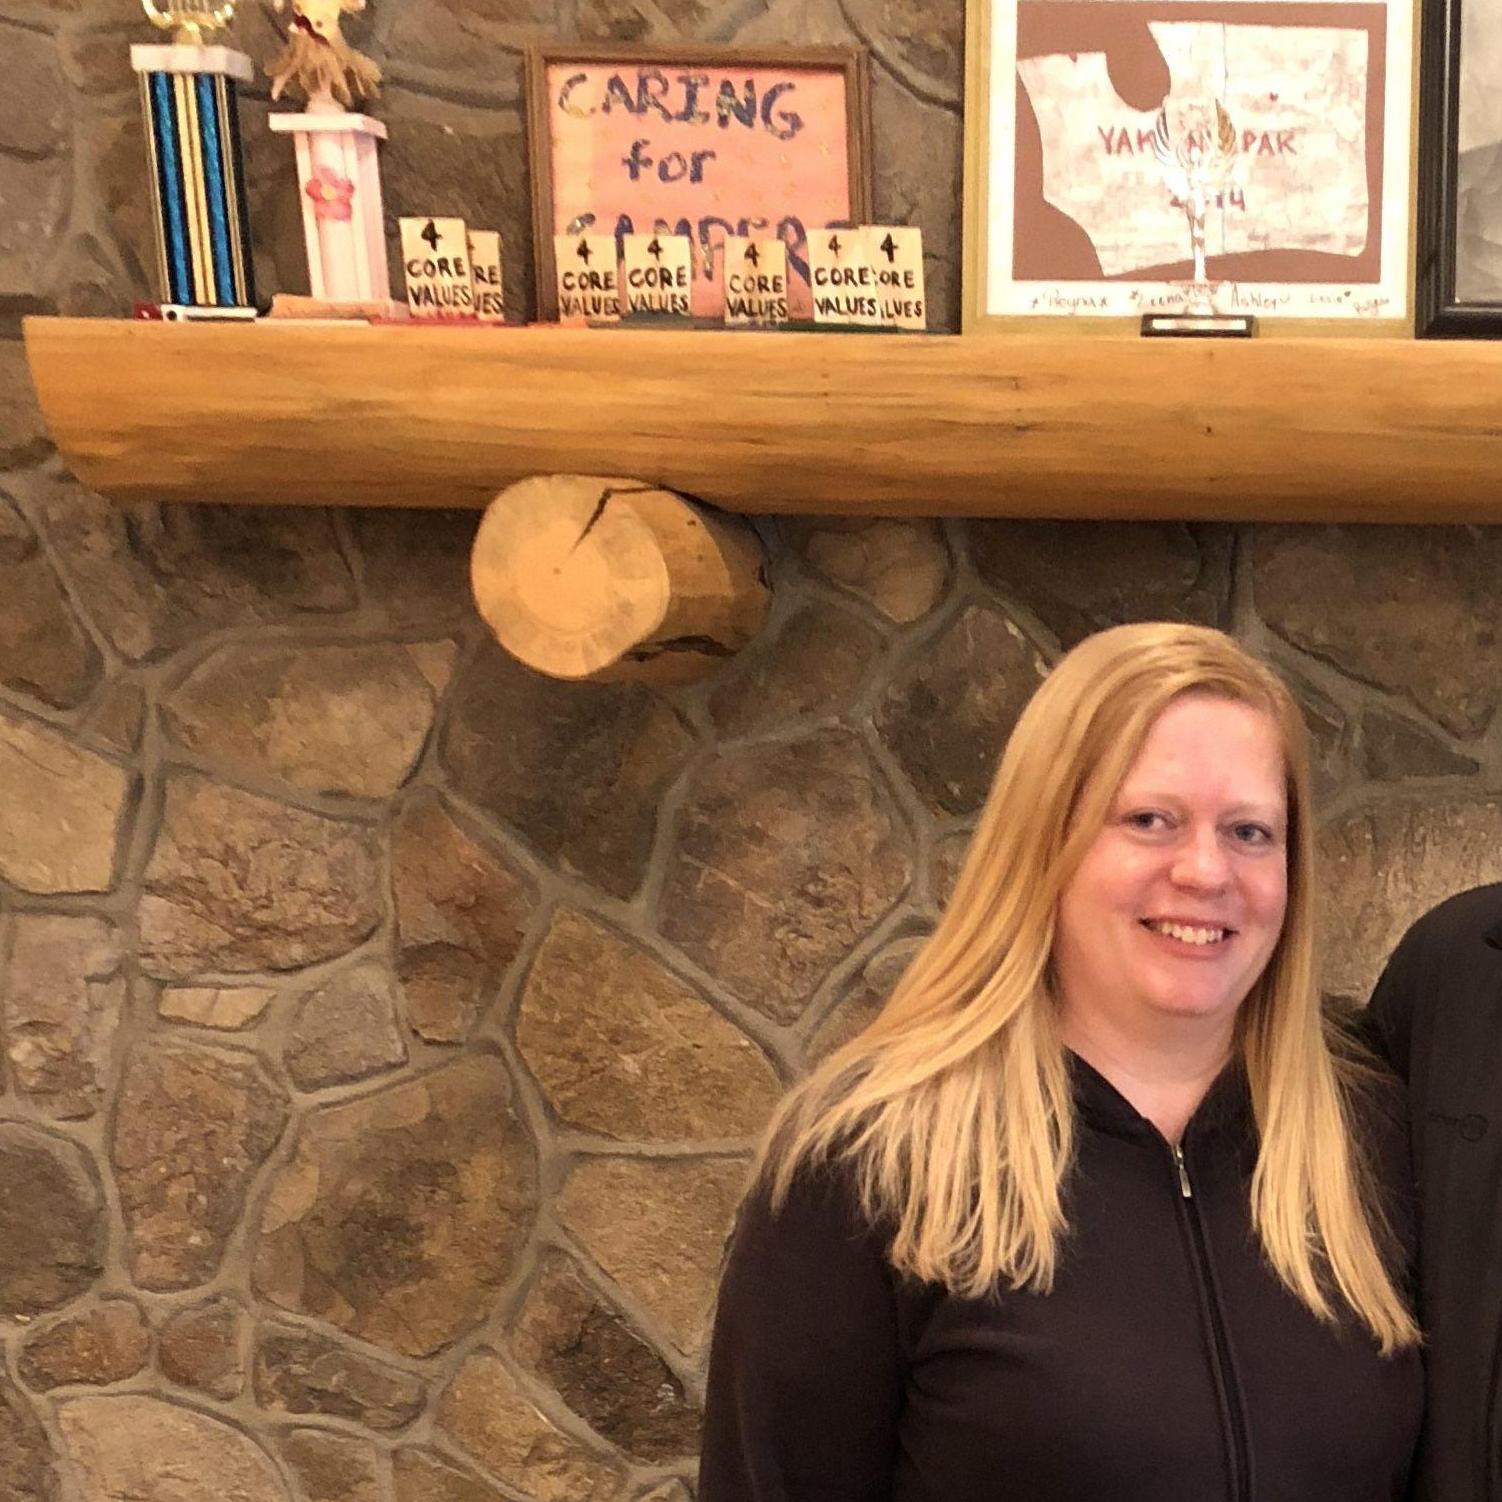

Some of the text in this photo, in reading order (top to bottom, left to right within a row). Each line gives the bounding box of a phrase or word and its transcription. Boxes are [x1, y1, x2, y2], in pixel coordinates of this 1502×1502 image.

[558, 68, 804, 140] CARING
[1241, 129, 1297, 156] PAK
[622, 139, 717, 183] for
[421, 219, 443, 251] 4
[828, 234, 842, 258] 4
[576, 239, 593, 266] 4
[647, 238, 663, 261] 4
[744, 242, 760, 267] 4
[880, 232, 899, 263] 4
[406, 257, 467, 278] CORE
[474, 265, 499, 285] RE
[628, 266, 688, 290] CORE
[814, 266, 871, 287] CORE
[872, 266, 915, 289] ORE
[562, 271, 617, 291] CORE
[729, 274, 784, 294] CORE
[408, 284, 475, 307] VALUES
[560, 295, 624, 316] VALUES
[628, 293, 690, 316] VALUES
[815, 296, 877, 317] VALUES
[726, 296, 788, 320] VALUES
